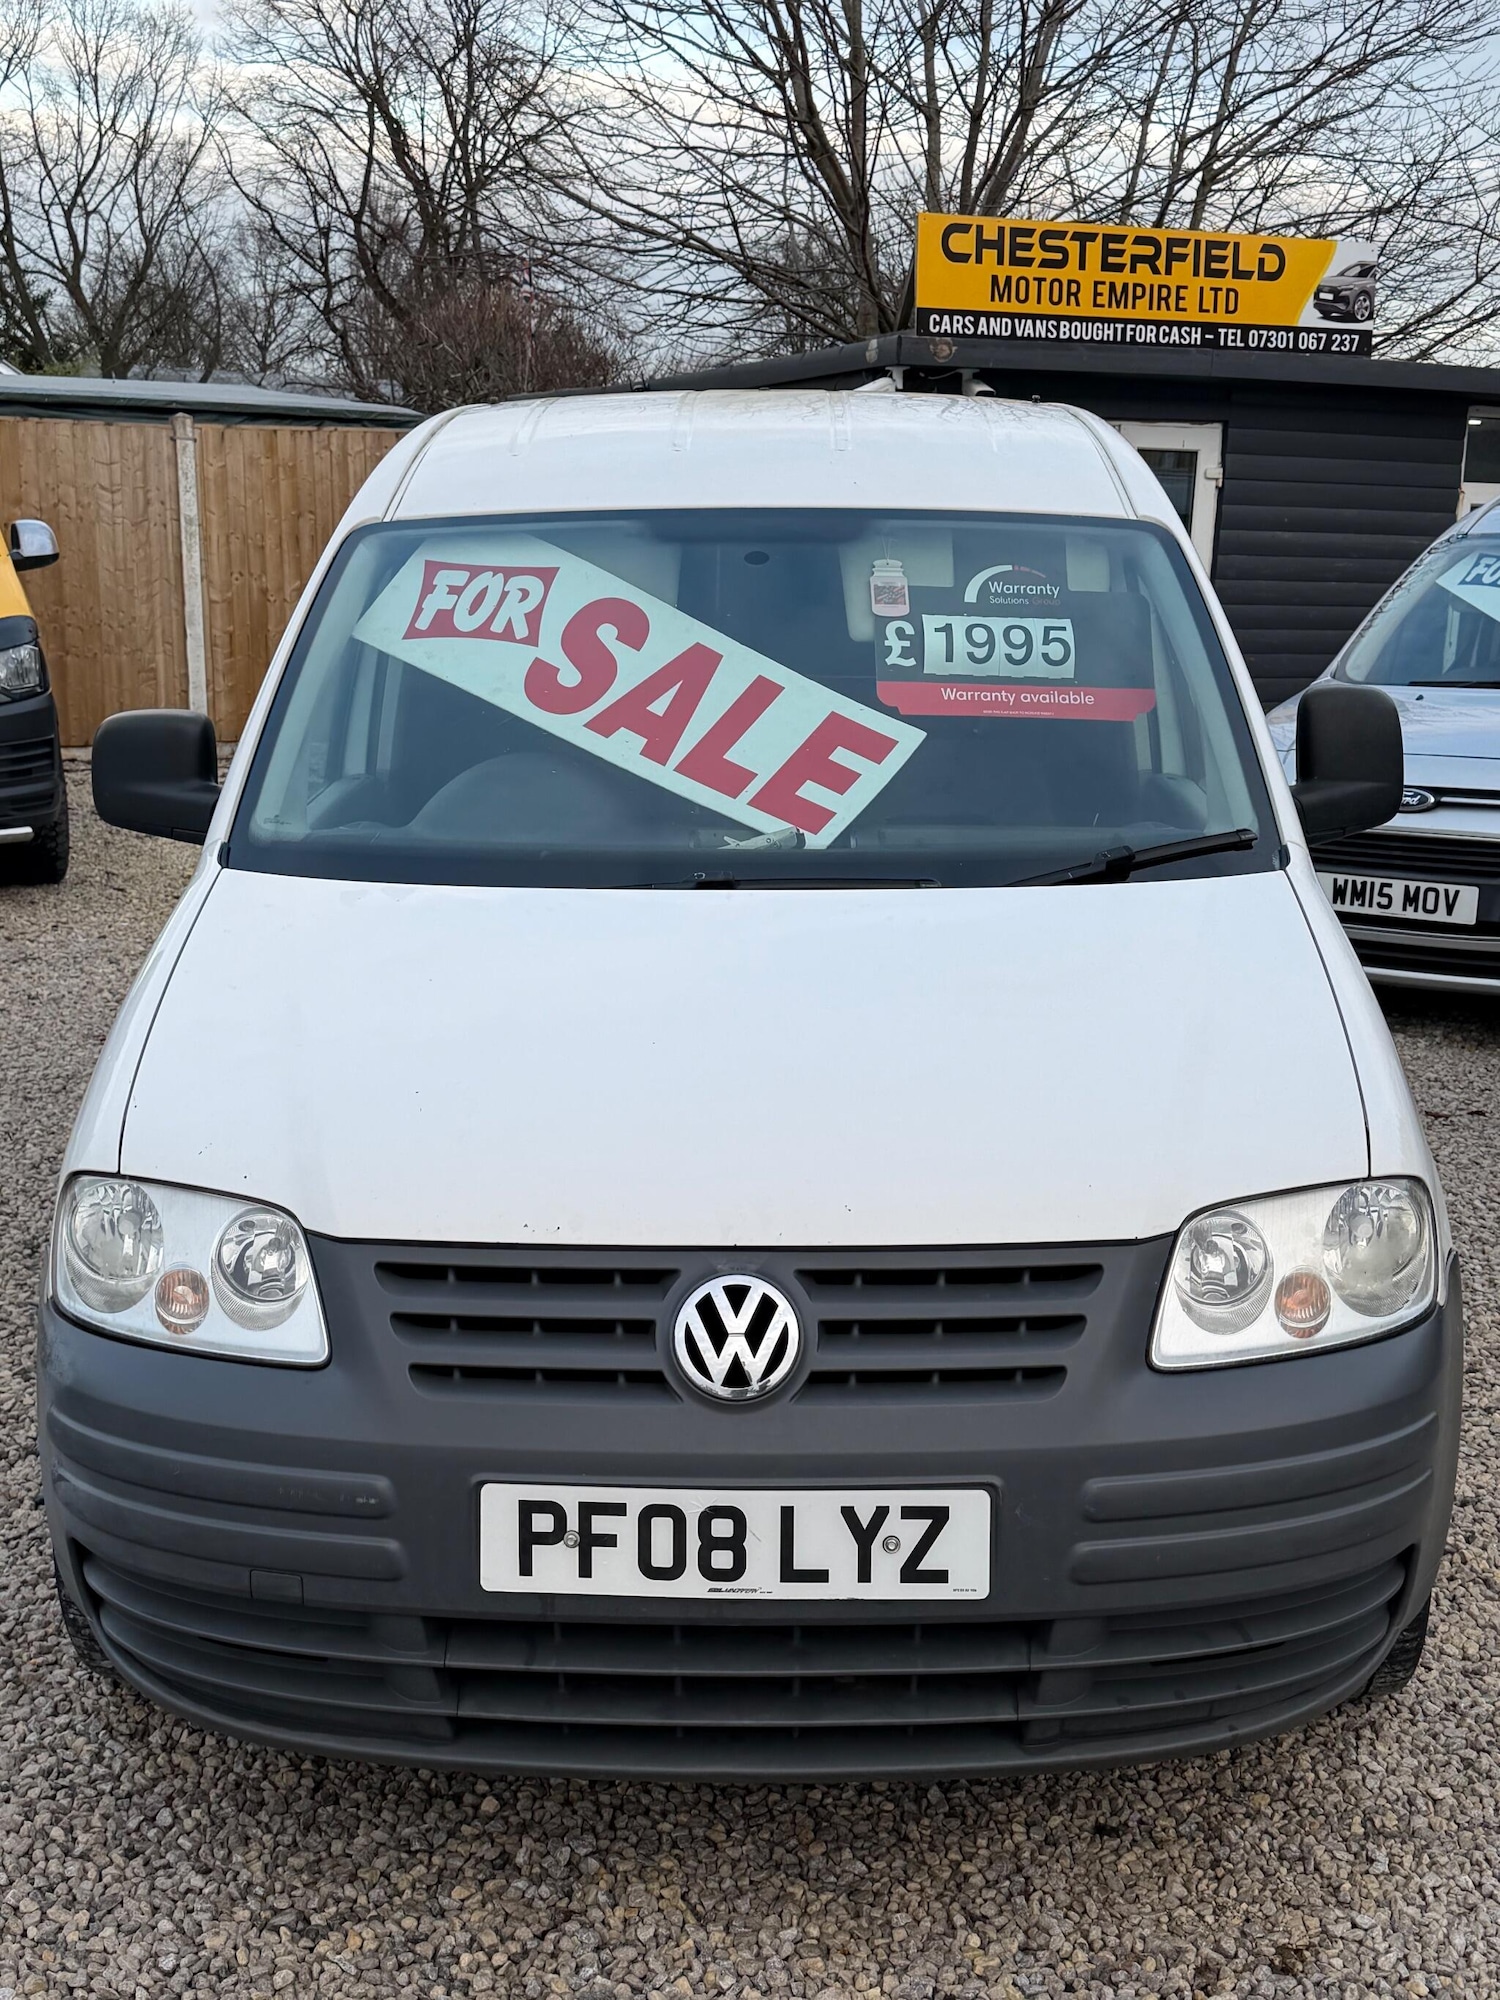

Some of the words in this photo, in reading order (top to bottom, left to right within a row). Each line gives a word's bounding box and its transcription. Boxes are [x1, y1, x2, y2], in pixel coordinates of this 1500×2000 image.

[941, 222, 1286, 282] CHESTERFIELD
[990, 275, 1081, 307] MOTOR
[1093, 280, 1188, 313] EMPIRE
[1198, 286, 1240, 315] LTD
[929, 314, 975, 335] CARS
[977, 316, 1012, 337] AND
[1014, 318, 1058, 339] VANS
[1059, 320, 1125, 342] BOUGHT
[1126, 324, 1157, 343] FOR
[1159, 325, 1202, 345] CASH
[1218, 328, 1245, 347] TEL
[1249, 330, 1294, 349] 07301
[1298, 332, 1327, 351] 067
[1330, 334, 1360, 352] 237
[988, 581, 1060, 599] Warranty
[1465, 556, 1500, 586] FO
[414, 569, 545, 640] FOR
[989, 596, 1030, 606] Solutions
[524, 596, 899, 836] SALE
[941, 687, 1016, 706] Warranty
[1020, 690, 1095, 705] available
[1332, 878, 1393, 910] WM15
[1402, 884, 1461, 917] MOV
[518, 1499, 748, 1583] PF08
[779, 1505, 950, 1584] LYZ
